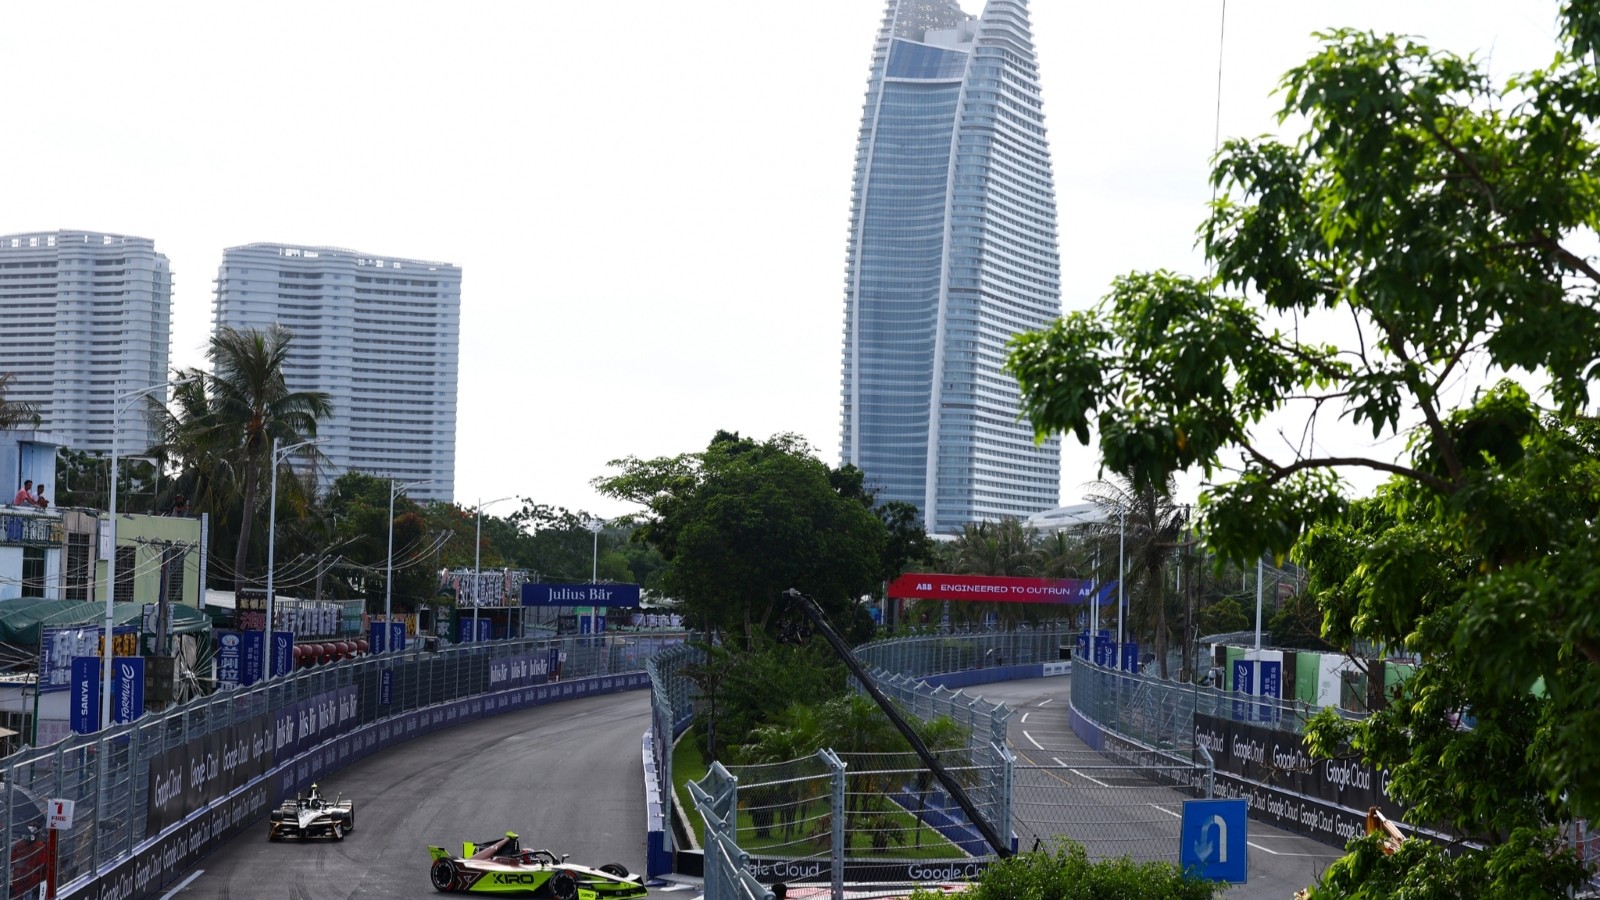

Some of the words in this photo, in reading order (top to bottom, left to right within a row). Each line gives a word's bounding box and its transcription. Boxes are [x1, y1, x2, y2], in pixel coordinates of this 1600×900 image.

[548, 588, 585, 603] Julius
[589, 588, 613, 600] Bär
[940, 584, 1008, 593] ENGINEERED
[1026, 587, 1070, 595] OUTRUN
[121, 677, 130, 719] FORMULA
[1195, 725, 1211, 751] Google
[1211, 730, 1224, 752] Cloud
[1233, 734, 1250, 765] Google
[1250, 739, 1265, 763] Cloud
[1273, 744, 1295, 777] Google
[1296, 750, 1314, 775] Cloud
[1326, 759, 1350, 791] Google
[1351, 763, 1370, 790] Cloud
[1213, 777, 1227, 799] Google
[1227, 782, 1238, 799] Cloud
[1253, 791, 1265, 810] Cloud
[1267, 793, 1284, 821] Google
[1284, 800, 1298, 821] Cloud
[1300, 803, 1318, 832] Google
[1318, 810, 1333, 832] Cloud
[1335, 813, 1355, 842] Google
[163, 839, 177, 871] Google
[177, 833, 188, 861] Cloud
[119, 867, 133, 900] Cloud
[135, 857, 150, 892] Google
[150, 849, 161, 879] Cloud
[748, 860, 769, 879] gle
[773, 861, 819, 877] Cloud
[908, 863, 961, 882] Google
